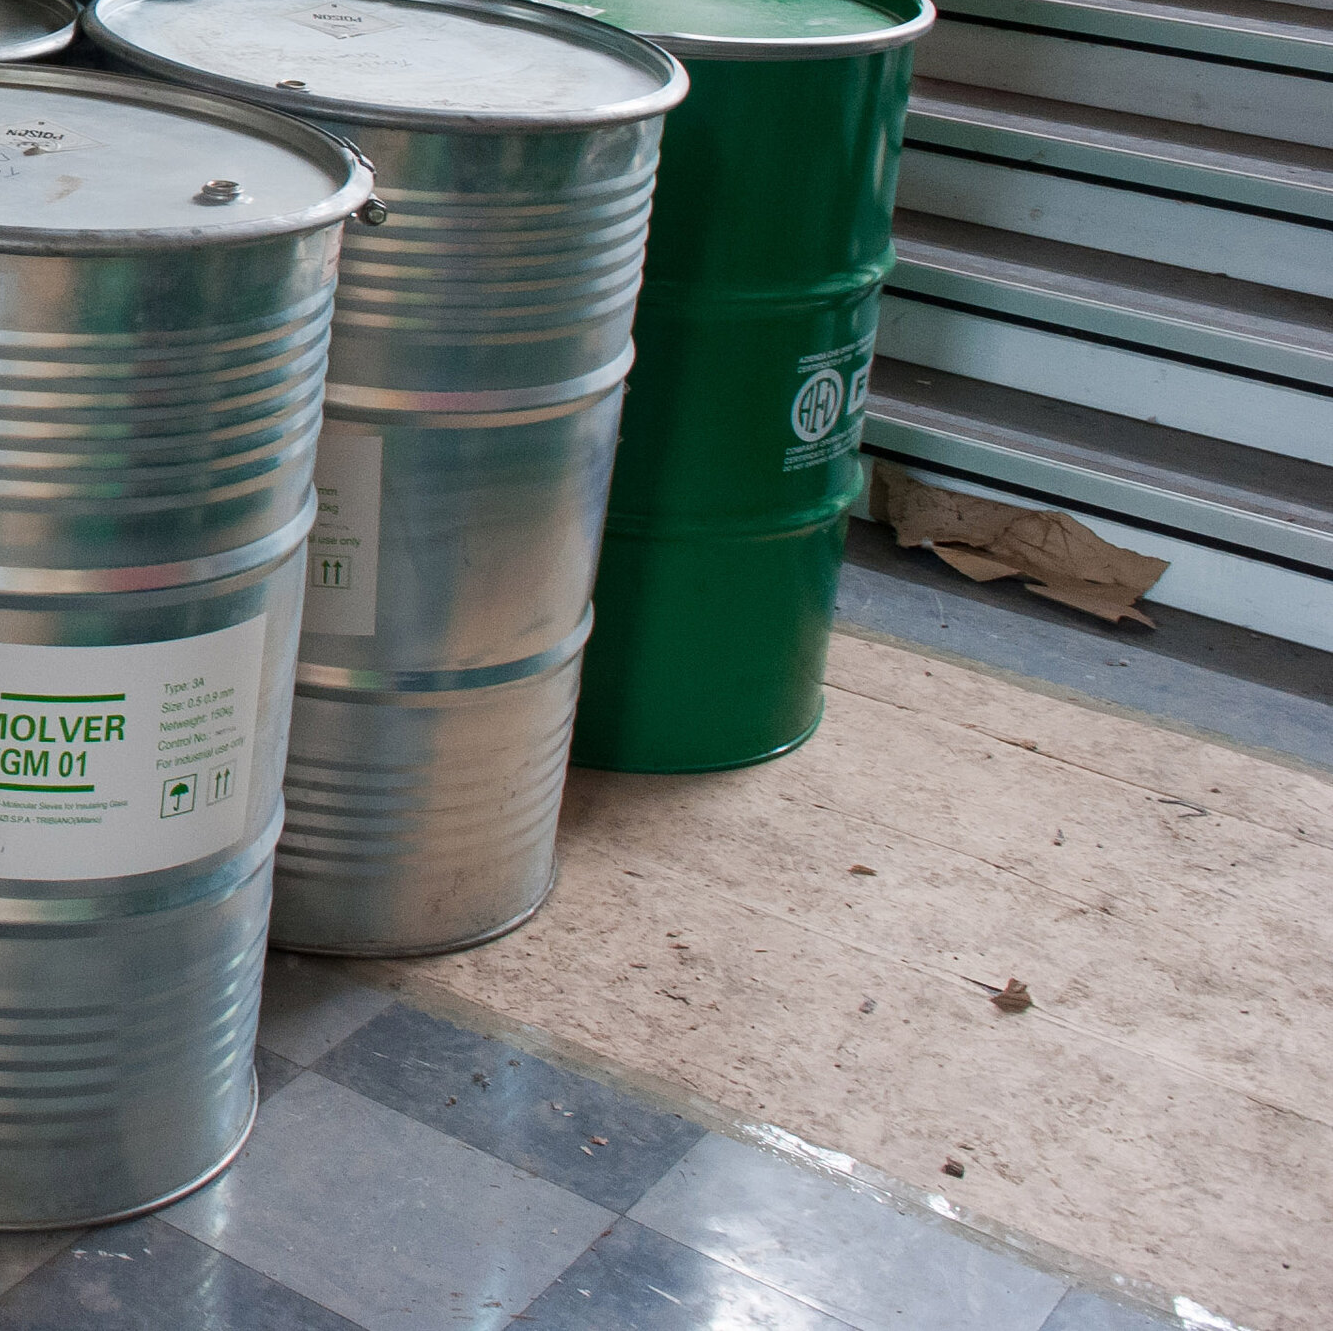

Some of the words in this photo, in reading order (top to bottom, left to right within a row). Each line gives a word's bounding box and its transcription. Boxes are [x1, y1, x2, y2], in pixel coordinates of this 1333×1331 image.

[313, 13, 362, 24] POISON
[6, 127, 65, 142] POISON
[318, 536, 338, 546] use
[339, 536, 362, 549] only
[192, 677, 205, 689] 3A
[158, 734, 192, 751] Control
[58, 750, 87, 778] 01
[156, 758, 172, 770] For
